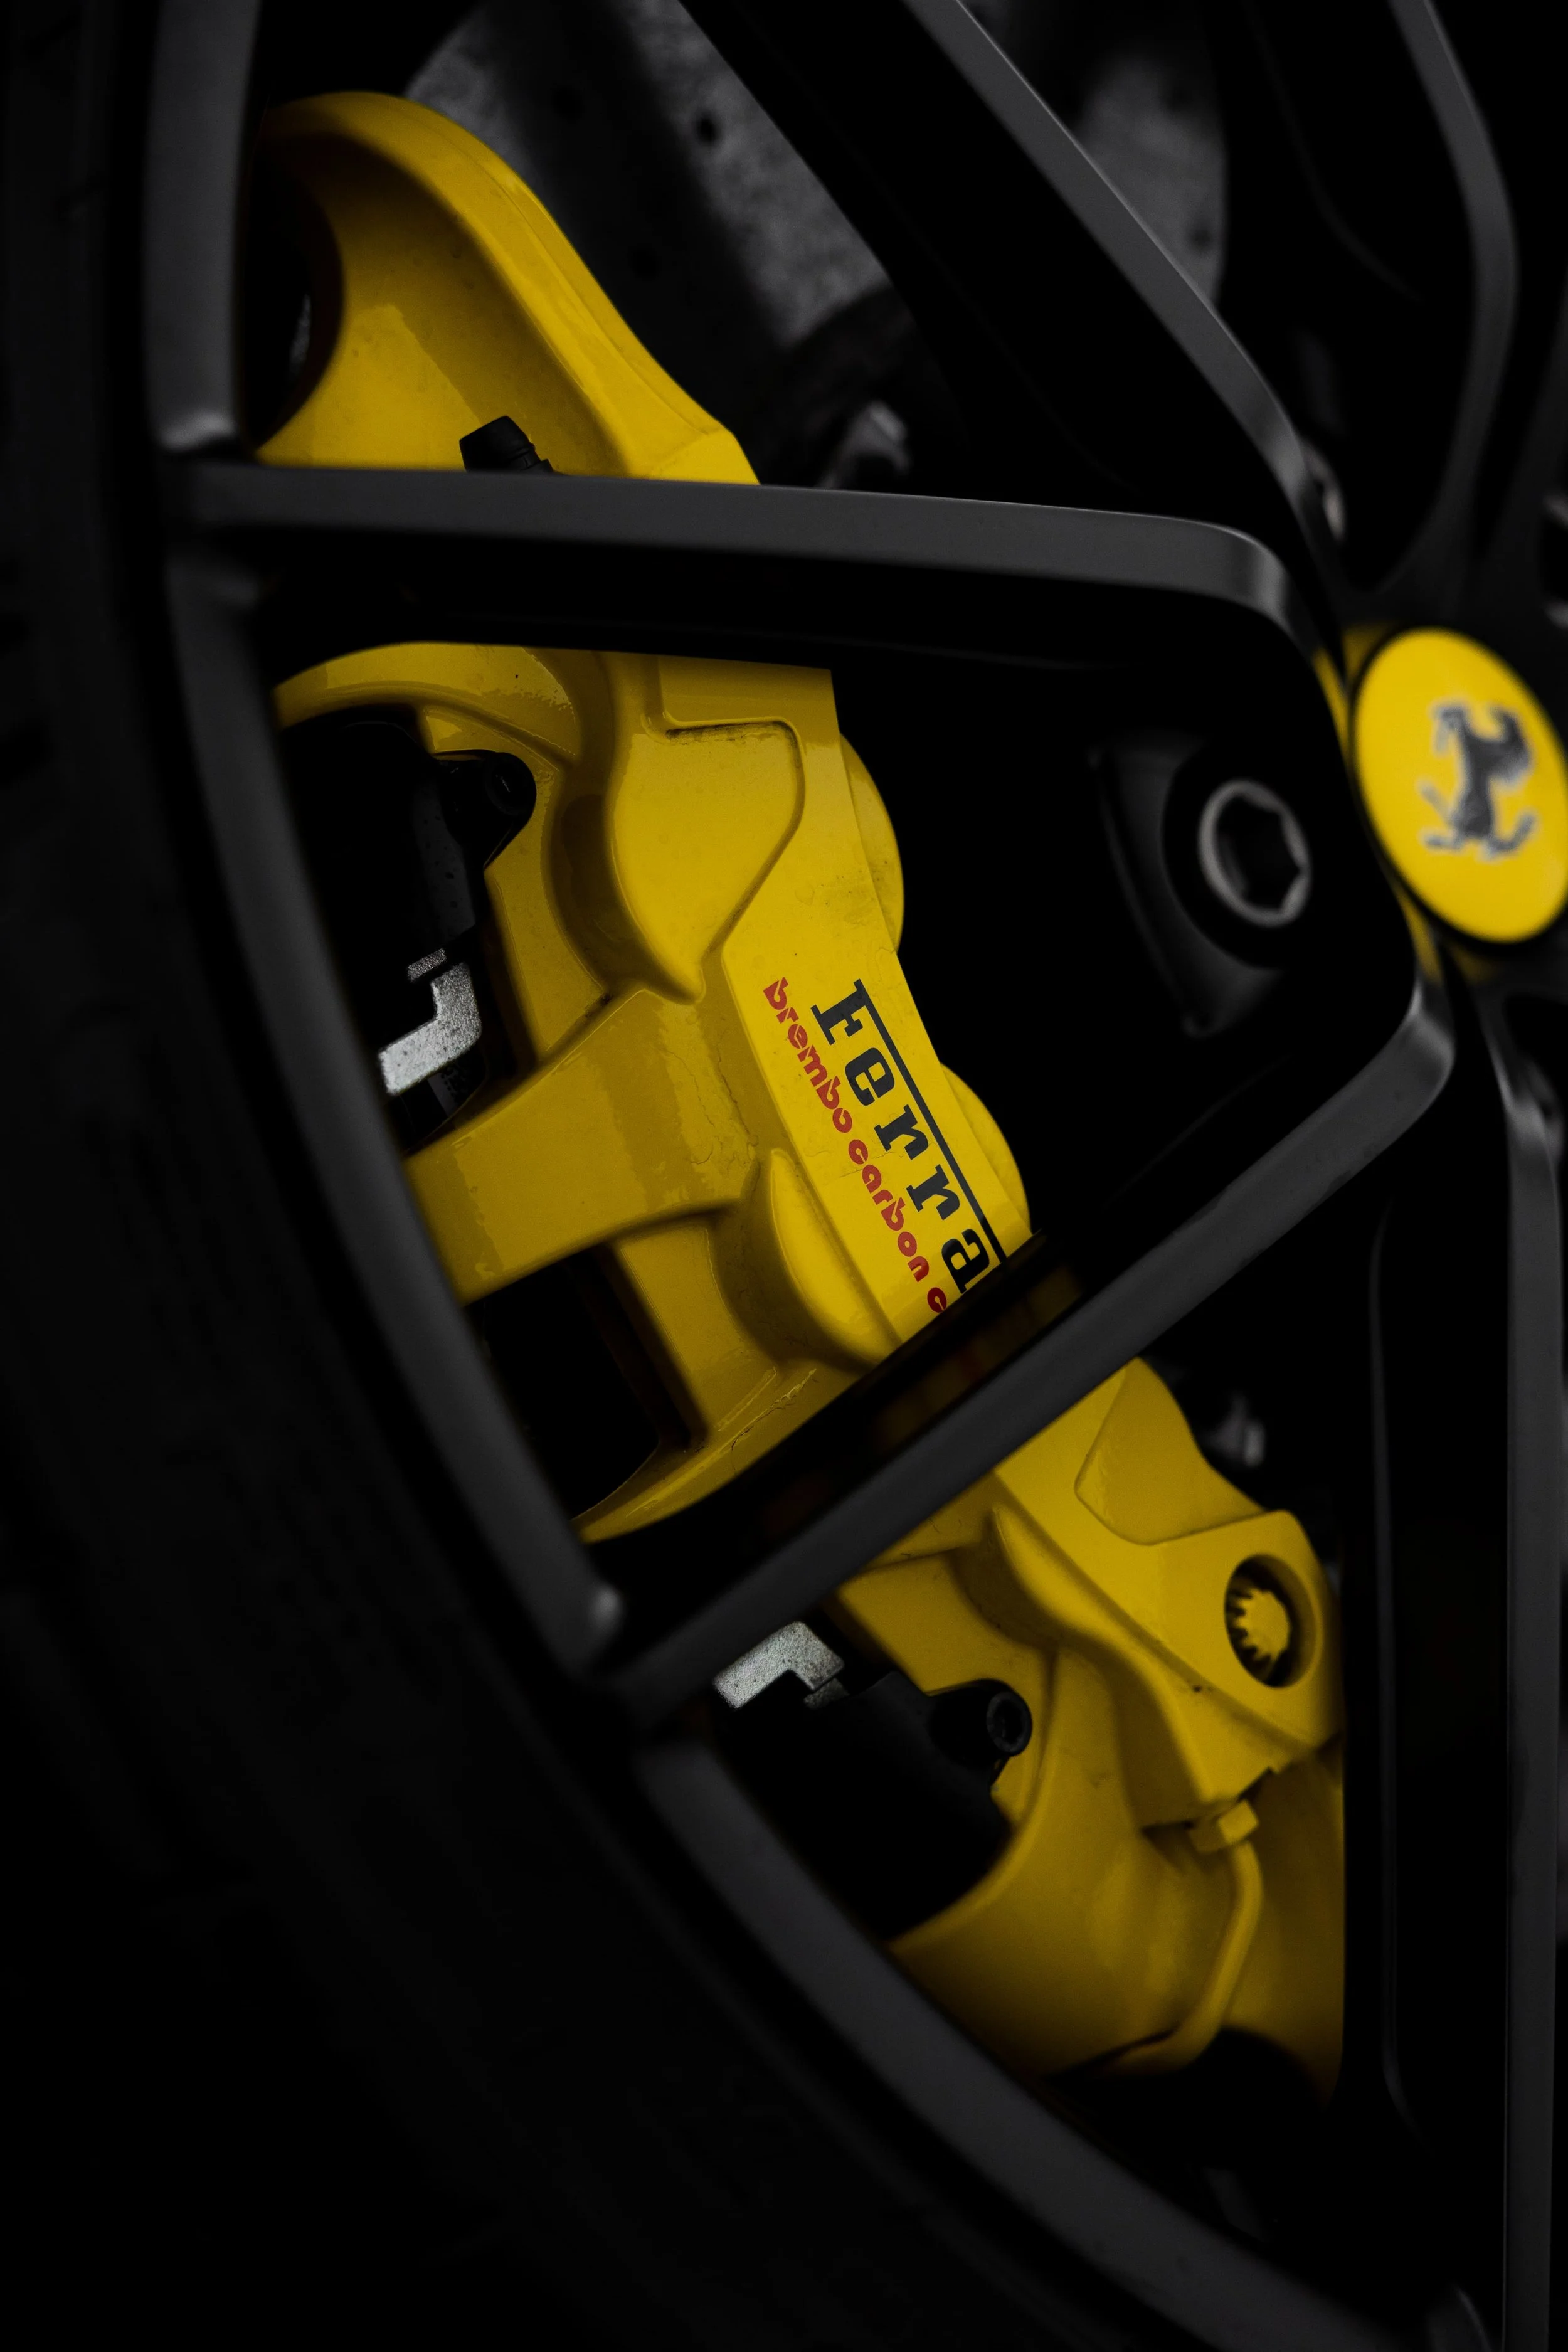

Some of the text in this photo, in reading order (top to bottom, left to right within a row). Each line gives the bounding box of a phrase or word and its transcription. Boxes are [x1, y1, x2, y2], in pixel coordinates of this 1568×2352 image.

[763, 977, 852, 1133] brembo
[848, 1139, 930, 1282] carbon
[810, 979, 1005, 1293] Ferra
